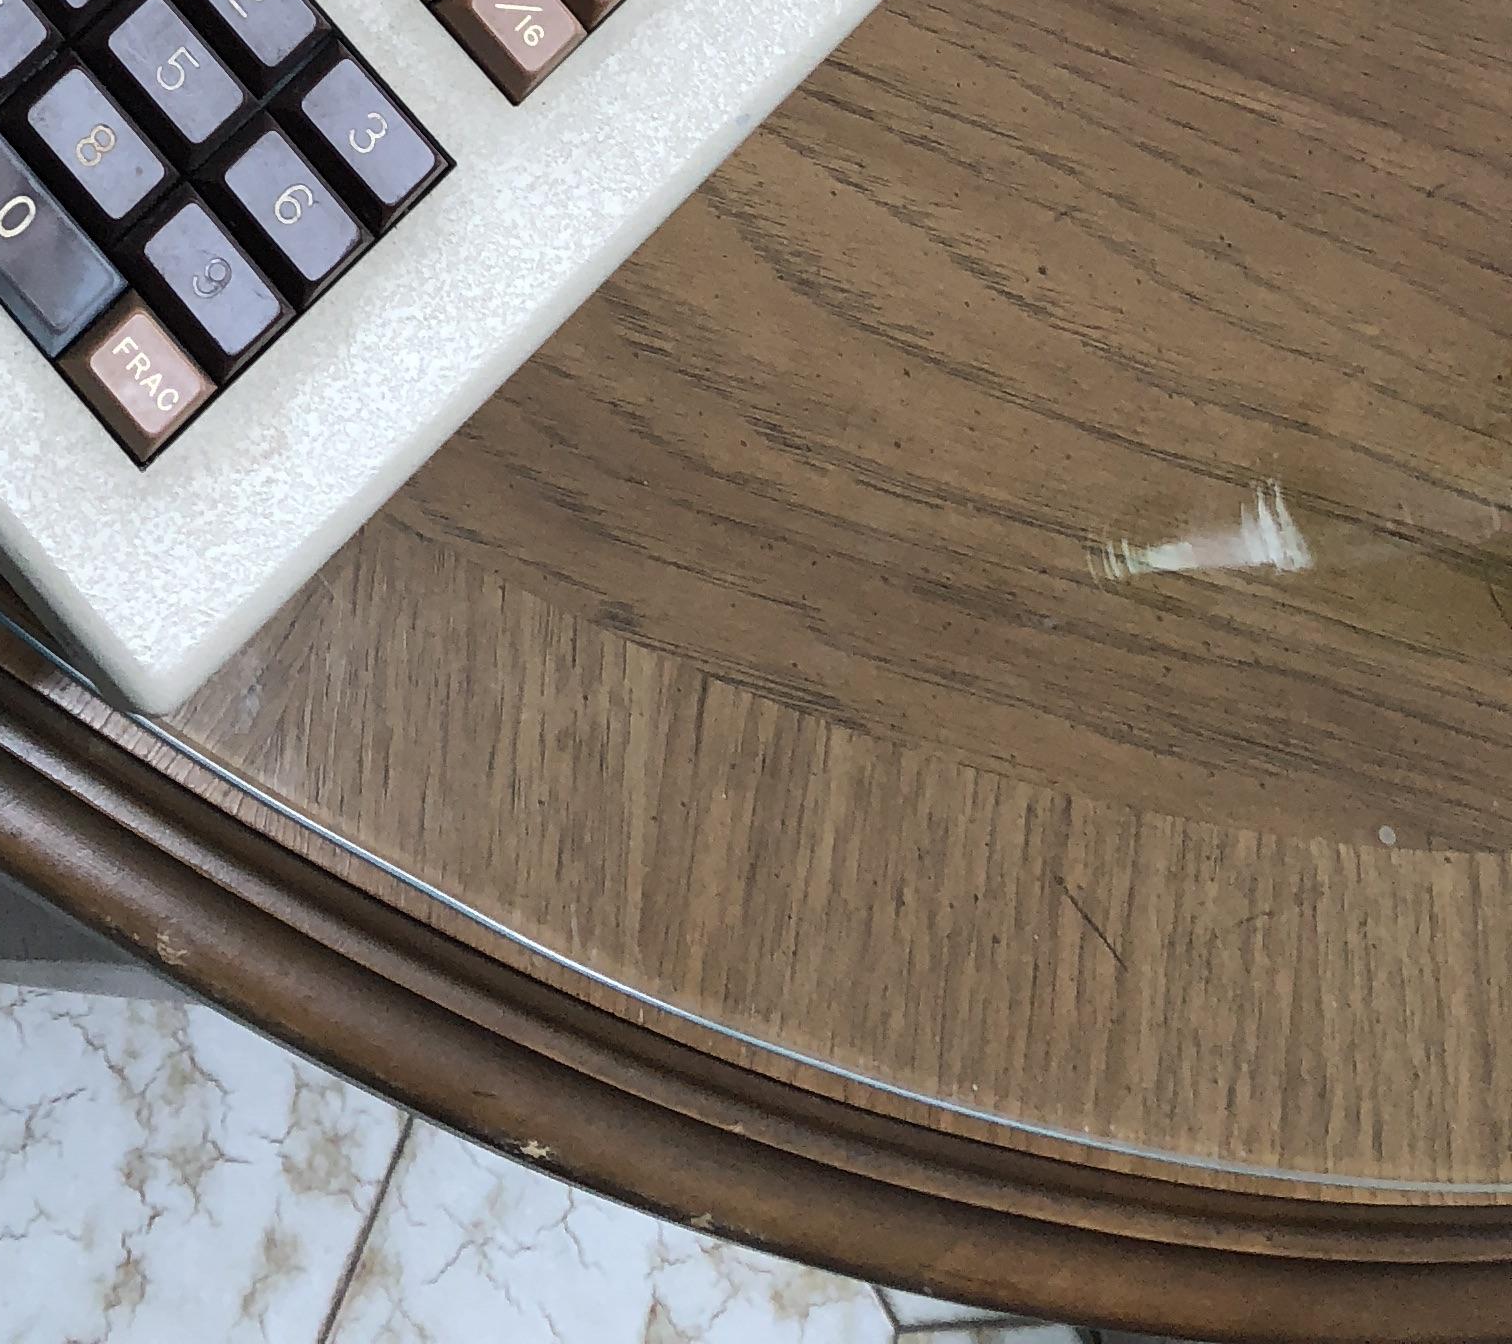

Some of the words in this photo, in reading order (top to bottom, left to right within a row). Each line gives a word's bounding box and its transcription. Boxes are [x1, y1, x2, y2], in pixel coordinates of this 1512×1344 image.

[156, 46, 200, 91] 5
[74, 124, 118, 167] 8
[348, 112, 389, 155] 3
[274, 183, 316, 225] 6
[191, 257, 233, 299] 9
[111, 335, 180, 412] FRAC
